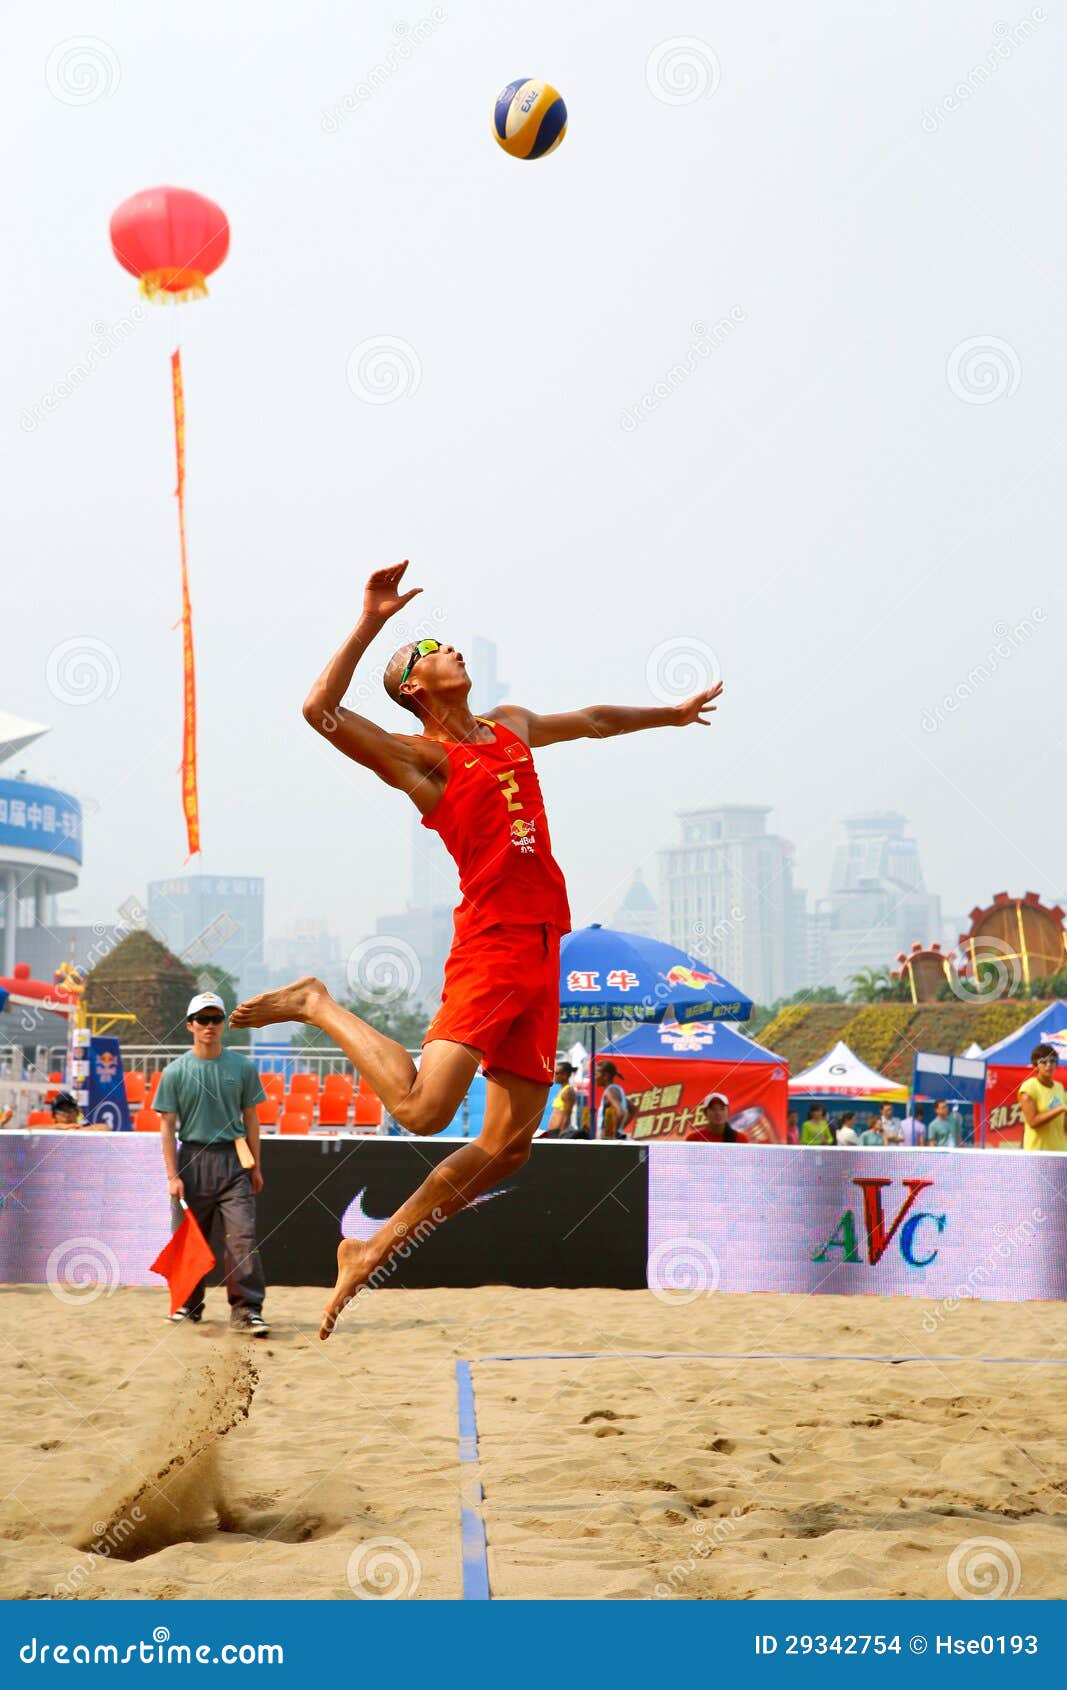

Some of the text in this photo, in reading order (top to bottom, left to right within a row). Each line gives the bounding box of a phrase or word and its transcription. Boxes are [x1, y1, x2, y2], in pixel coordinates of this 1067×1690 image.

[497, 770, 523, 812] 2
[567, 970, 639, 991] 红牛
[811, 1178, 946, 1267] AVC
